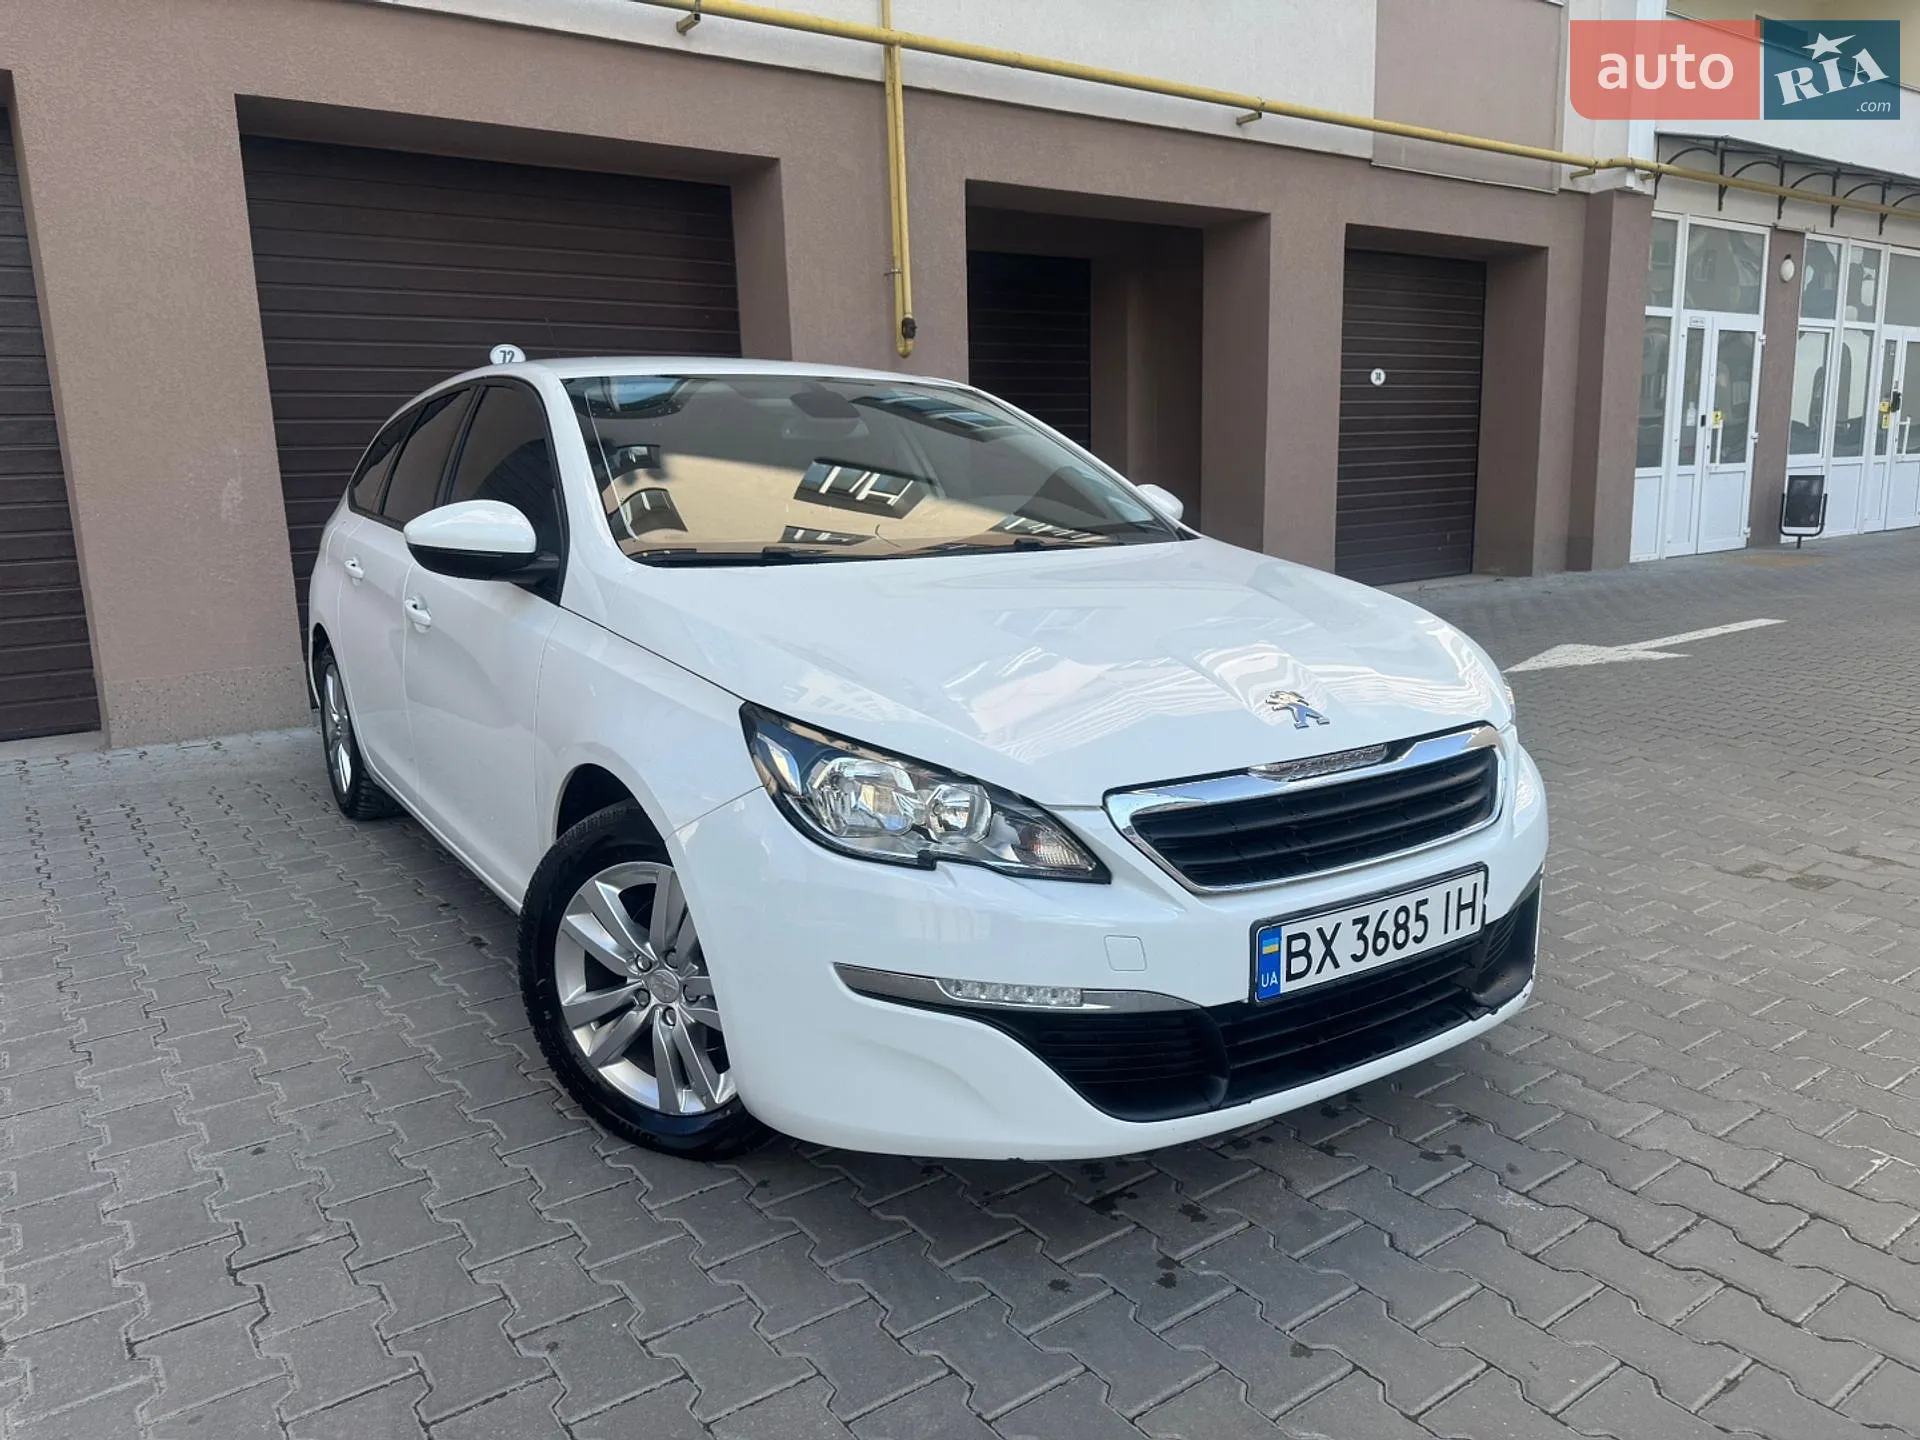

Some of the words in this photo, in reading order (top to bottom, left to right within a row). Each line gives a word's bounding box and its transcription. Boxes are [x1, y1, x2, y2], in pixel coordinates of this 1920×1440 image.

[1286, 922, 1342, 982] BX
[1350, 898, 1430, 963] 3685
[1443, 882, 1478, 934] IH
[1261, 971, 1279, 988] UA
